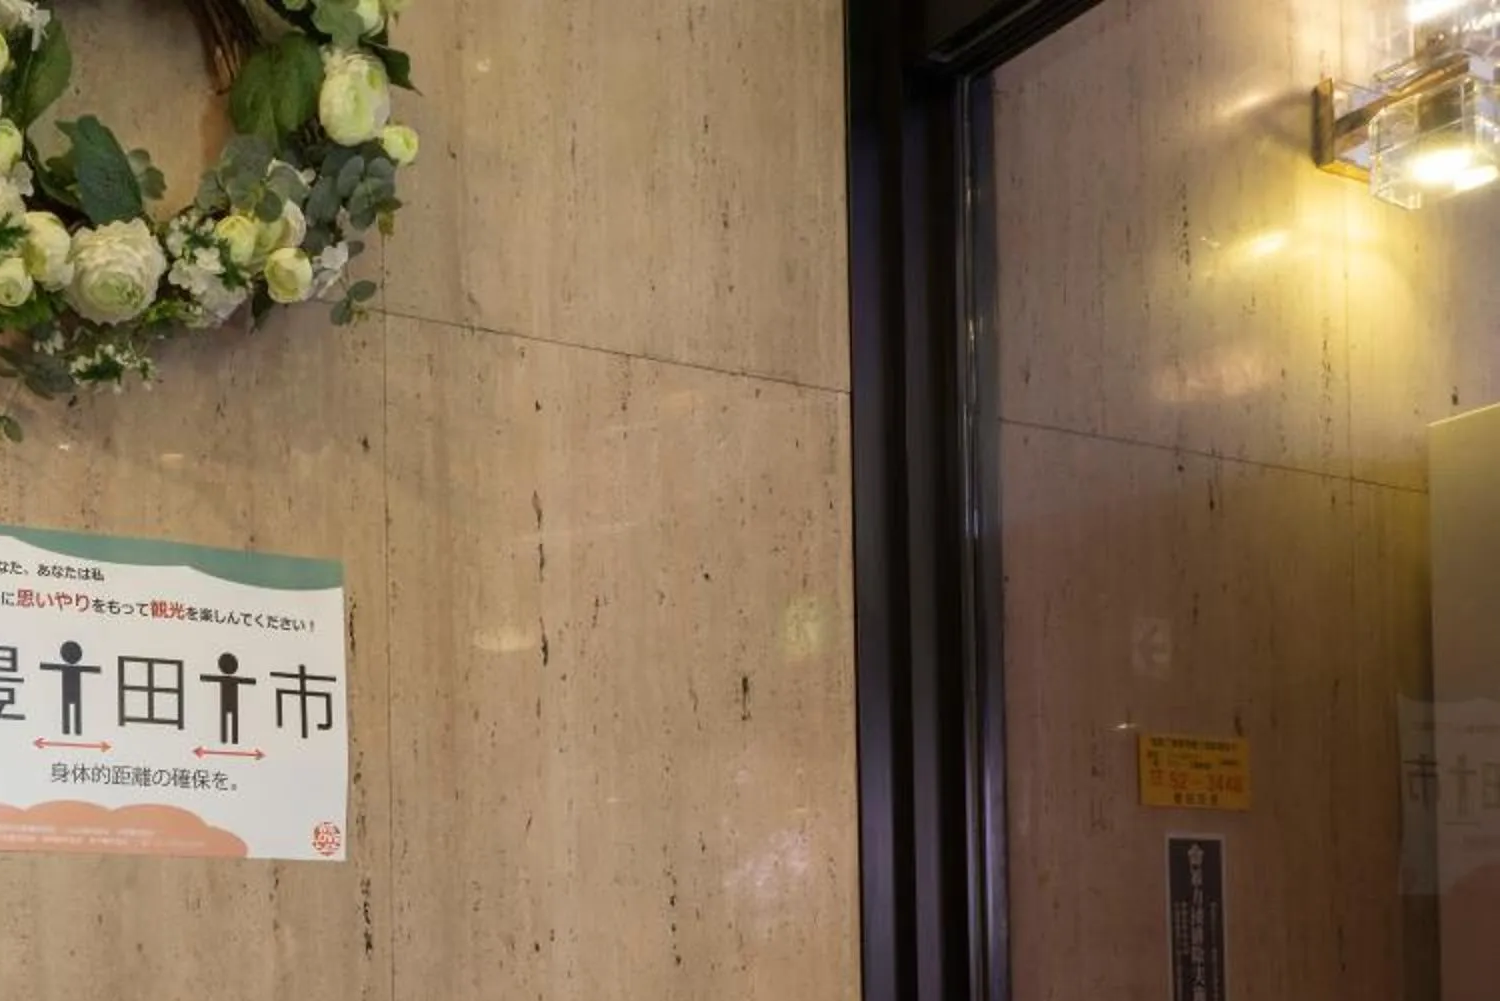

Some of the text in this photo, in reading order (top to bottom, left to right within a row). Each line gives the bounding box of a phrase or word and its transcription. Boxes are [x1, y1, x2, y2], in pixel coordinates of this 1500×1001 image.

[118, 655, 185, 731] 田
[270, 664, 337, 740] 市
[51, 761, 239, 792] 身体的距離の確保を。
